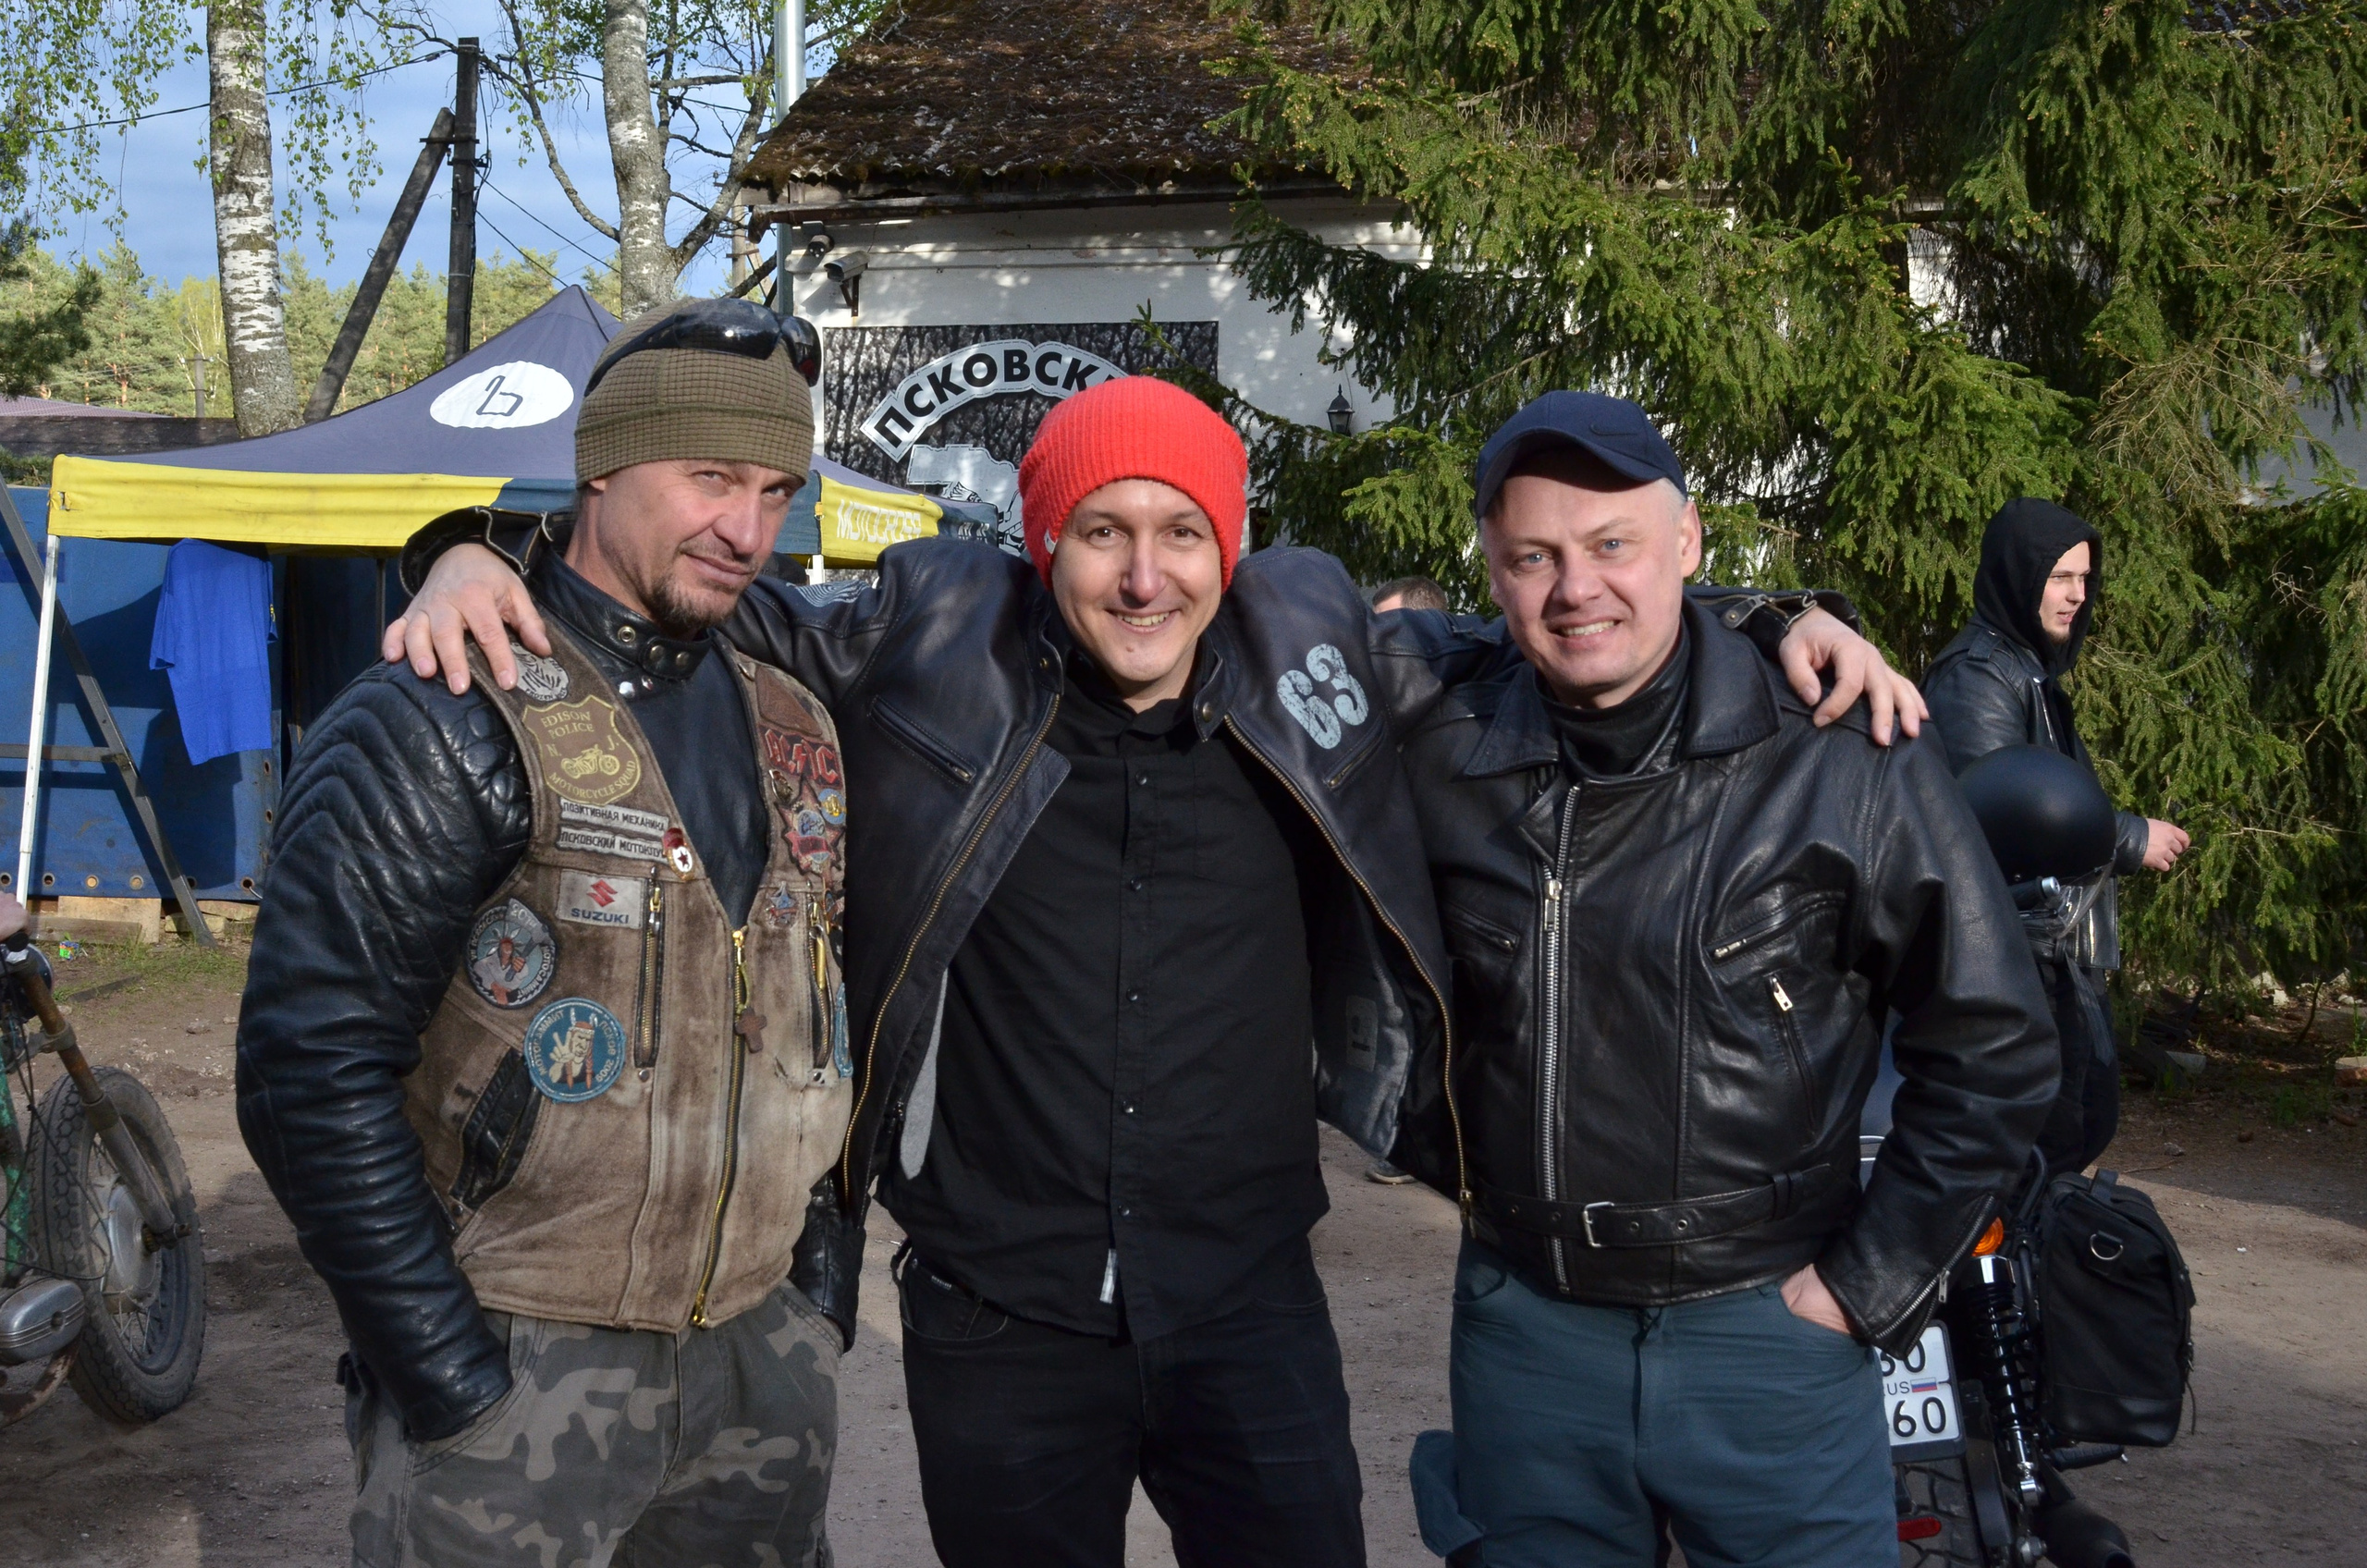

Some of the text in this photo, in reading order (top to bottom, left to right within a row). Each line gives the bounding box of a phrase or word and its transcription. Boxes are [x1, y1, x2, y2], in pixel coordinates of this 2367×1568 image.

[874, 349, 1116, 448] ПСКОВСК
[1277, 643, 1368, 750] 63
[540, 710, 592, 728] EDISON
[547, 721, 595, 740] POLICE
[548, 760, 638, 799] MOTORCYCLE SQUAD
[562, 802, 665, 831] ПОЗИТИВНАЯ МЕХАНИКА
[560, 830, 665, 858] ПСКОВСКИЙ МОТОКЛУ
[570, 907, 631, 925] SUZUKI
[595, 1059, 615, 1083] 2009
[1884, 1380, 1910, 1396] US
[1893, 1396, 1946, 1439] 60
